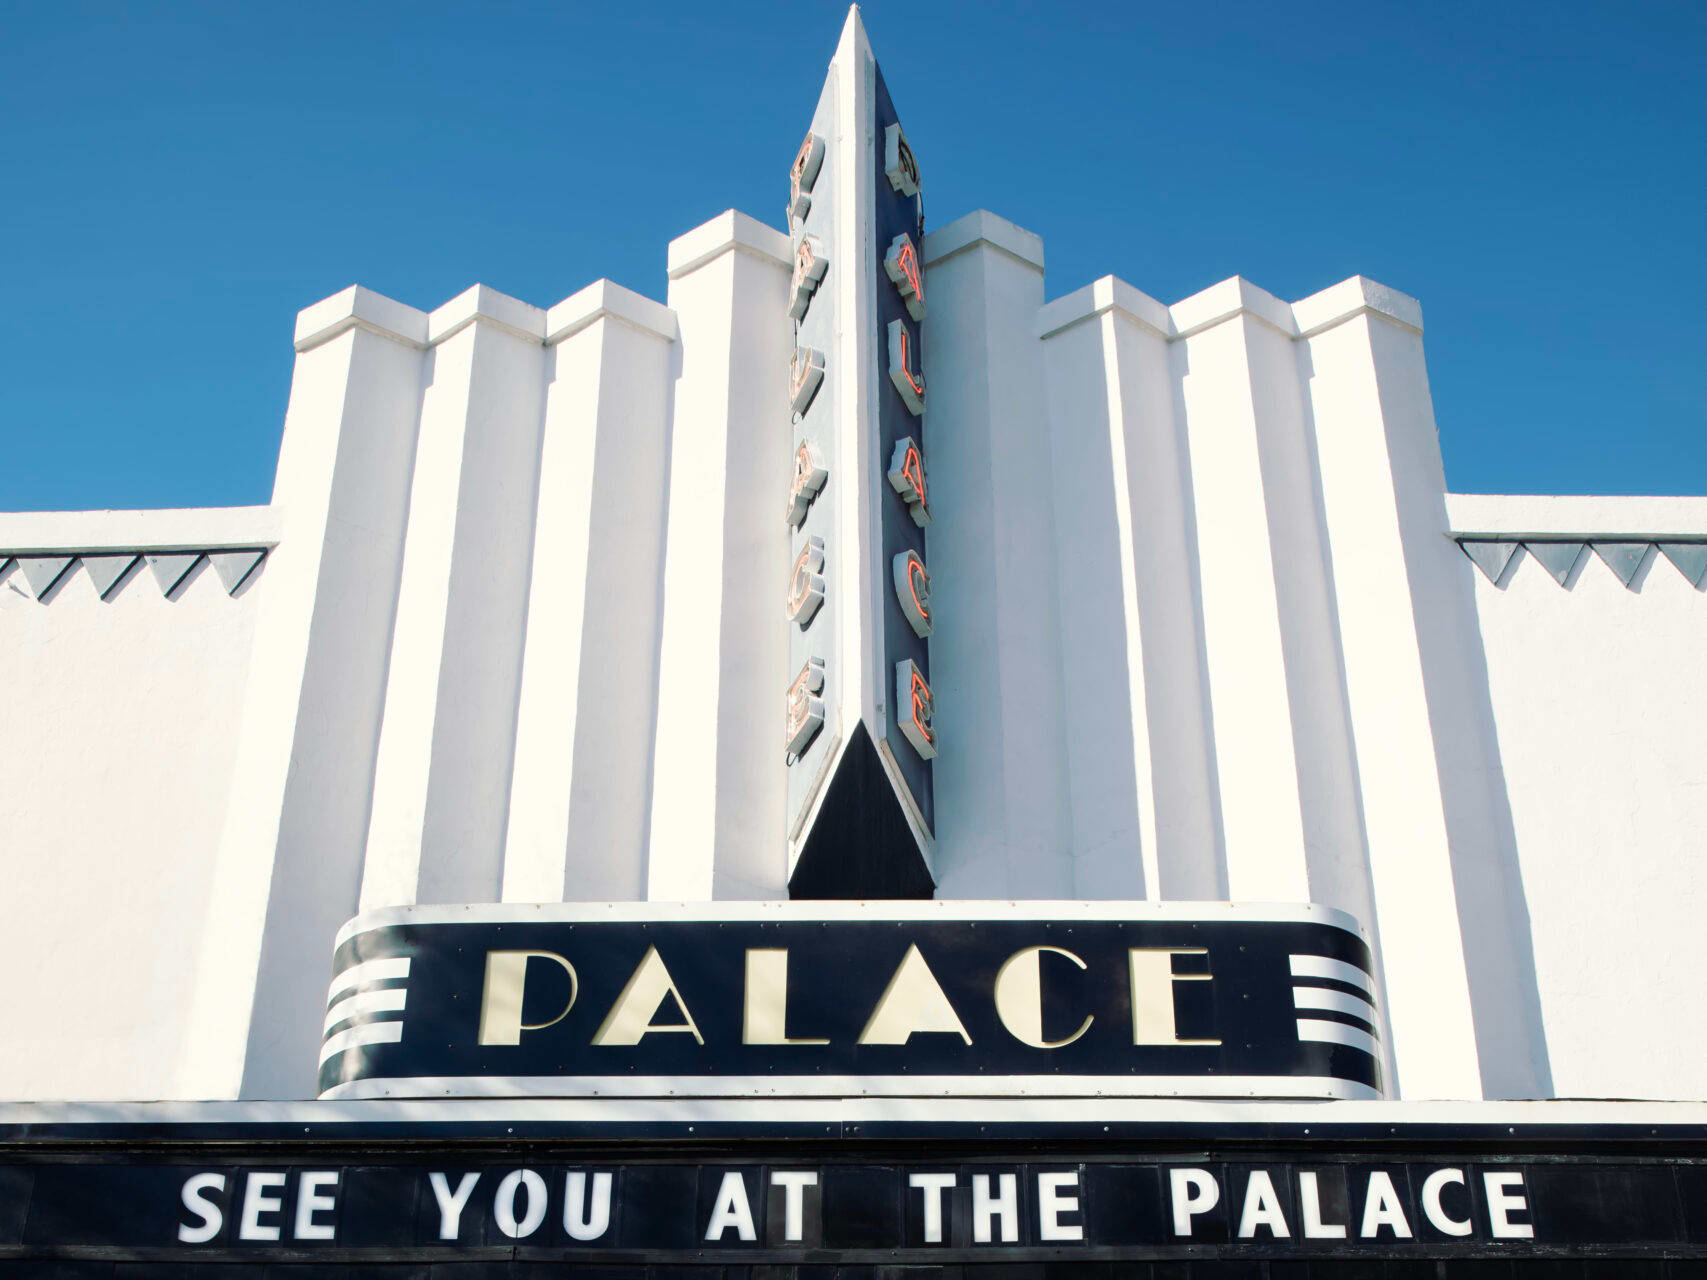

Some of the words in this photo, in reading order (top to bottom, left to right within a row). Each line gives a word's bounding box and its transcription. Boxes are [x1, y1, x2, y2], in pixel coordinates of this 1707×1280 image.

[883, 122, 937, 761] PALACE
[477, 943, 1223, 1049] PALACE
[178, 1171, 340, 1245] SEE
[429, 1168, 613, 1242] YOU
[704, 1171, 818, 1242] AT
[909, 1172, 1083, 1244] THE
[1169, 1167, 1534, 1240] PALACE
